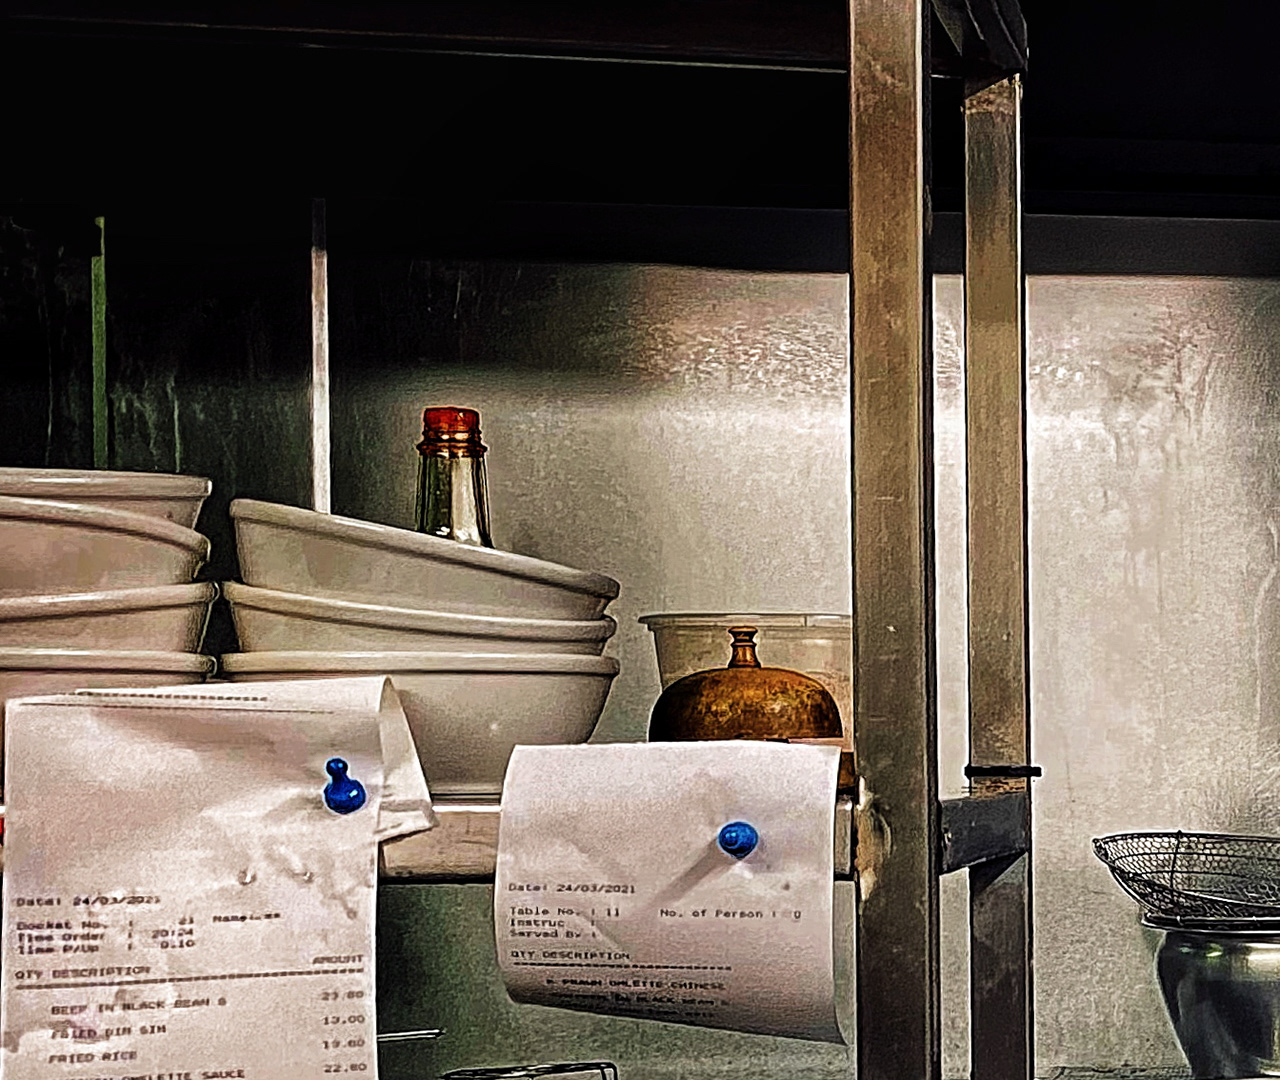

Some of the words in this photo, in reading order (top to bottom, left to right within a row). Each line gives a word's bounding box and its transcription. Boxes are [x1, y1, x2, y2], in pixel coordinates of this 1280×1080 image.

[508, 883, 547, 892] Date:
[556, 884, 636, 894] 24/03/2021
[510, 906, 550, 916] Table
[557, 907, 581, 916] No.
[606, 907, 620, 917] 11
[660, 908, 684, 918] No.
[691, 909, 707, 917] of
[715, 909, 763, 919] Person
[16, 921, 73, 931] Docket
[510, 918, 565, 927] Instruc
[18, 933, 54, 942] Time
[62, 933, 105, 941] Order
[509, 929, 559, 938] Served
[566, 930, 581, 939] By
[18, 945, 55, 954] Time
[511, 951, 535, 960] QTY
[542, 951, 630, 960] DESCRIPTION
[14, 971, 43, 980] QTY
[52, 966, 152, 979] DESCRIPTION
[312, 953, 364, 964] AMOUNT
[562, 979, 602, 987] PRAWN
[51, 1005, 88, 1016] BEEF
[99, 1003, 115, 1014] IN
[122, 1000, 165, 1011] BLACK
[173, 998, 210, 1009] BEAN
[105, 1026, 132, 1038] DIM
[48, 1053, 94, 1064] FRIED
[101, 1051, 138, 1061] RICE
[202, 1069, 245, 1080] SAUCE
